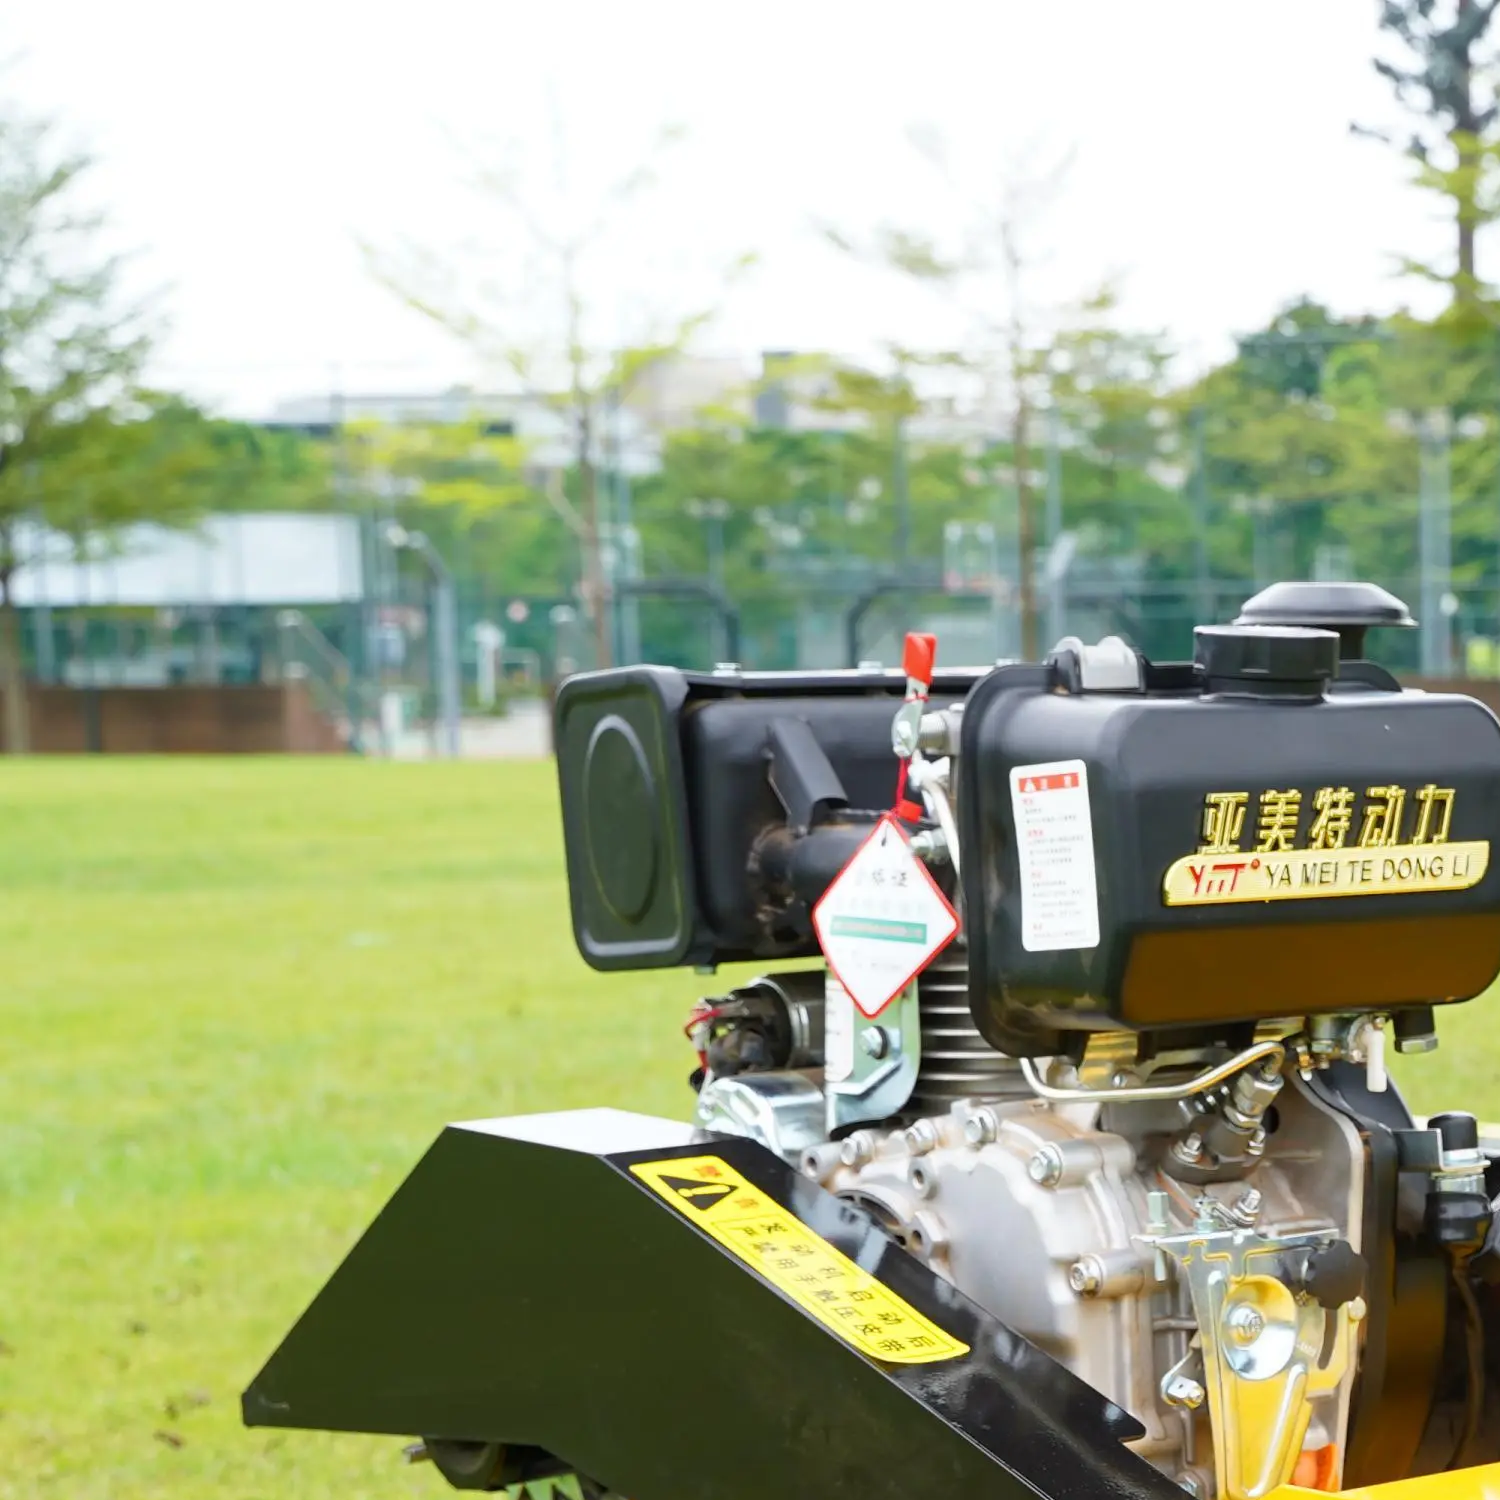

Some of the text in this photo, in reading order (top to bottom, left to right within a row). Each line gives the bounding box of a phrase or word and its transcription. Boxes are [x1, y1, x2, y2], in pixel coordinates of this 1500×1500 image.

[1194, 784, 1456, 855] 亚美特动力
[1266, 864, 1292, 888] YA
[1301, 861, 1339, 887] MEI
[1349, 859, 1373, 884] TE
[1382, 855, 1444, 882] DONG
[1452, 854, 1471, 877] LI
